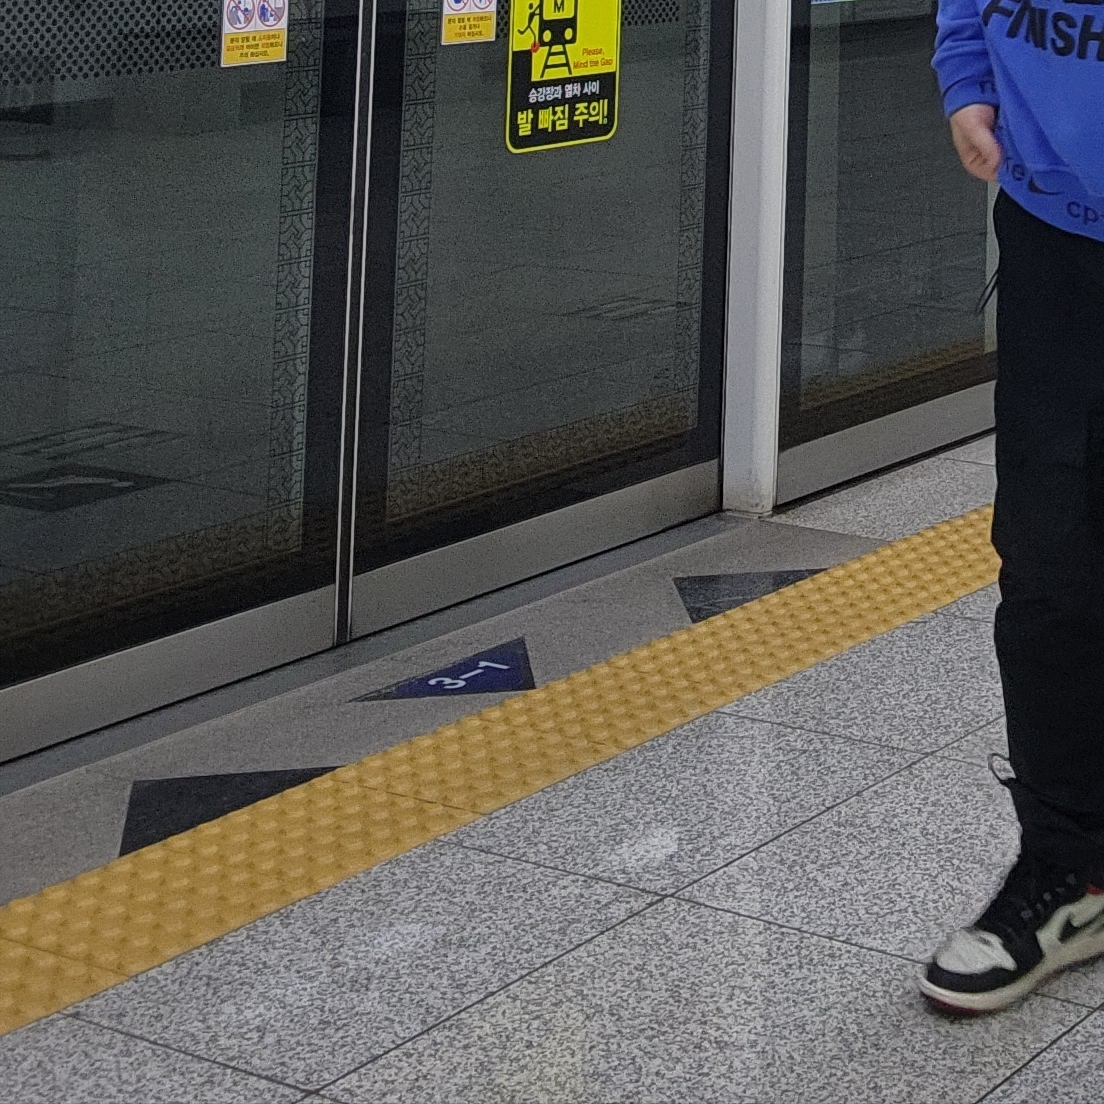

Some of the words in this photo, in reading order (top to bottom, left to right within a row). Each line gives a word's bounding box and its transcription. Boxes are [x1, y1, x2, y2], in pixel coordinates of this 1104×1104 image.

[528, 84, 562, 103] 승강장과
[565, 82, 581, 99] 열차
[583, 79, 600, 95] 사이
[517, 109, 533, 136] 발
[538, 104, 569, 132] 빠짐
[574, 99, 608, 127] 주의!
[428, 660, 510, 690] 3-1
